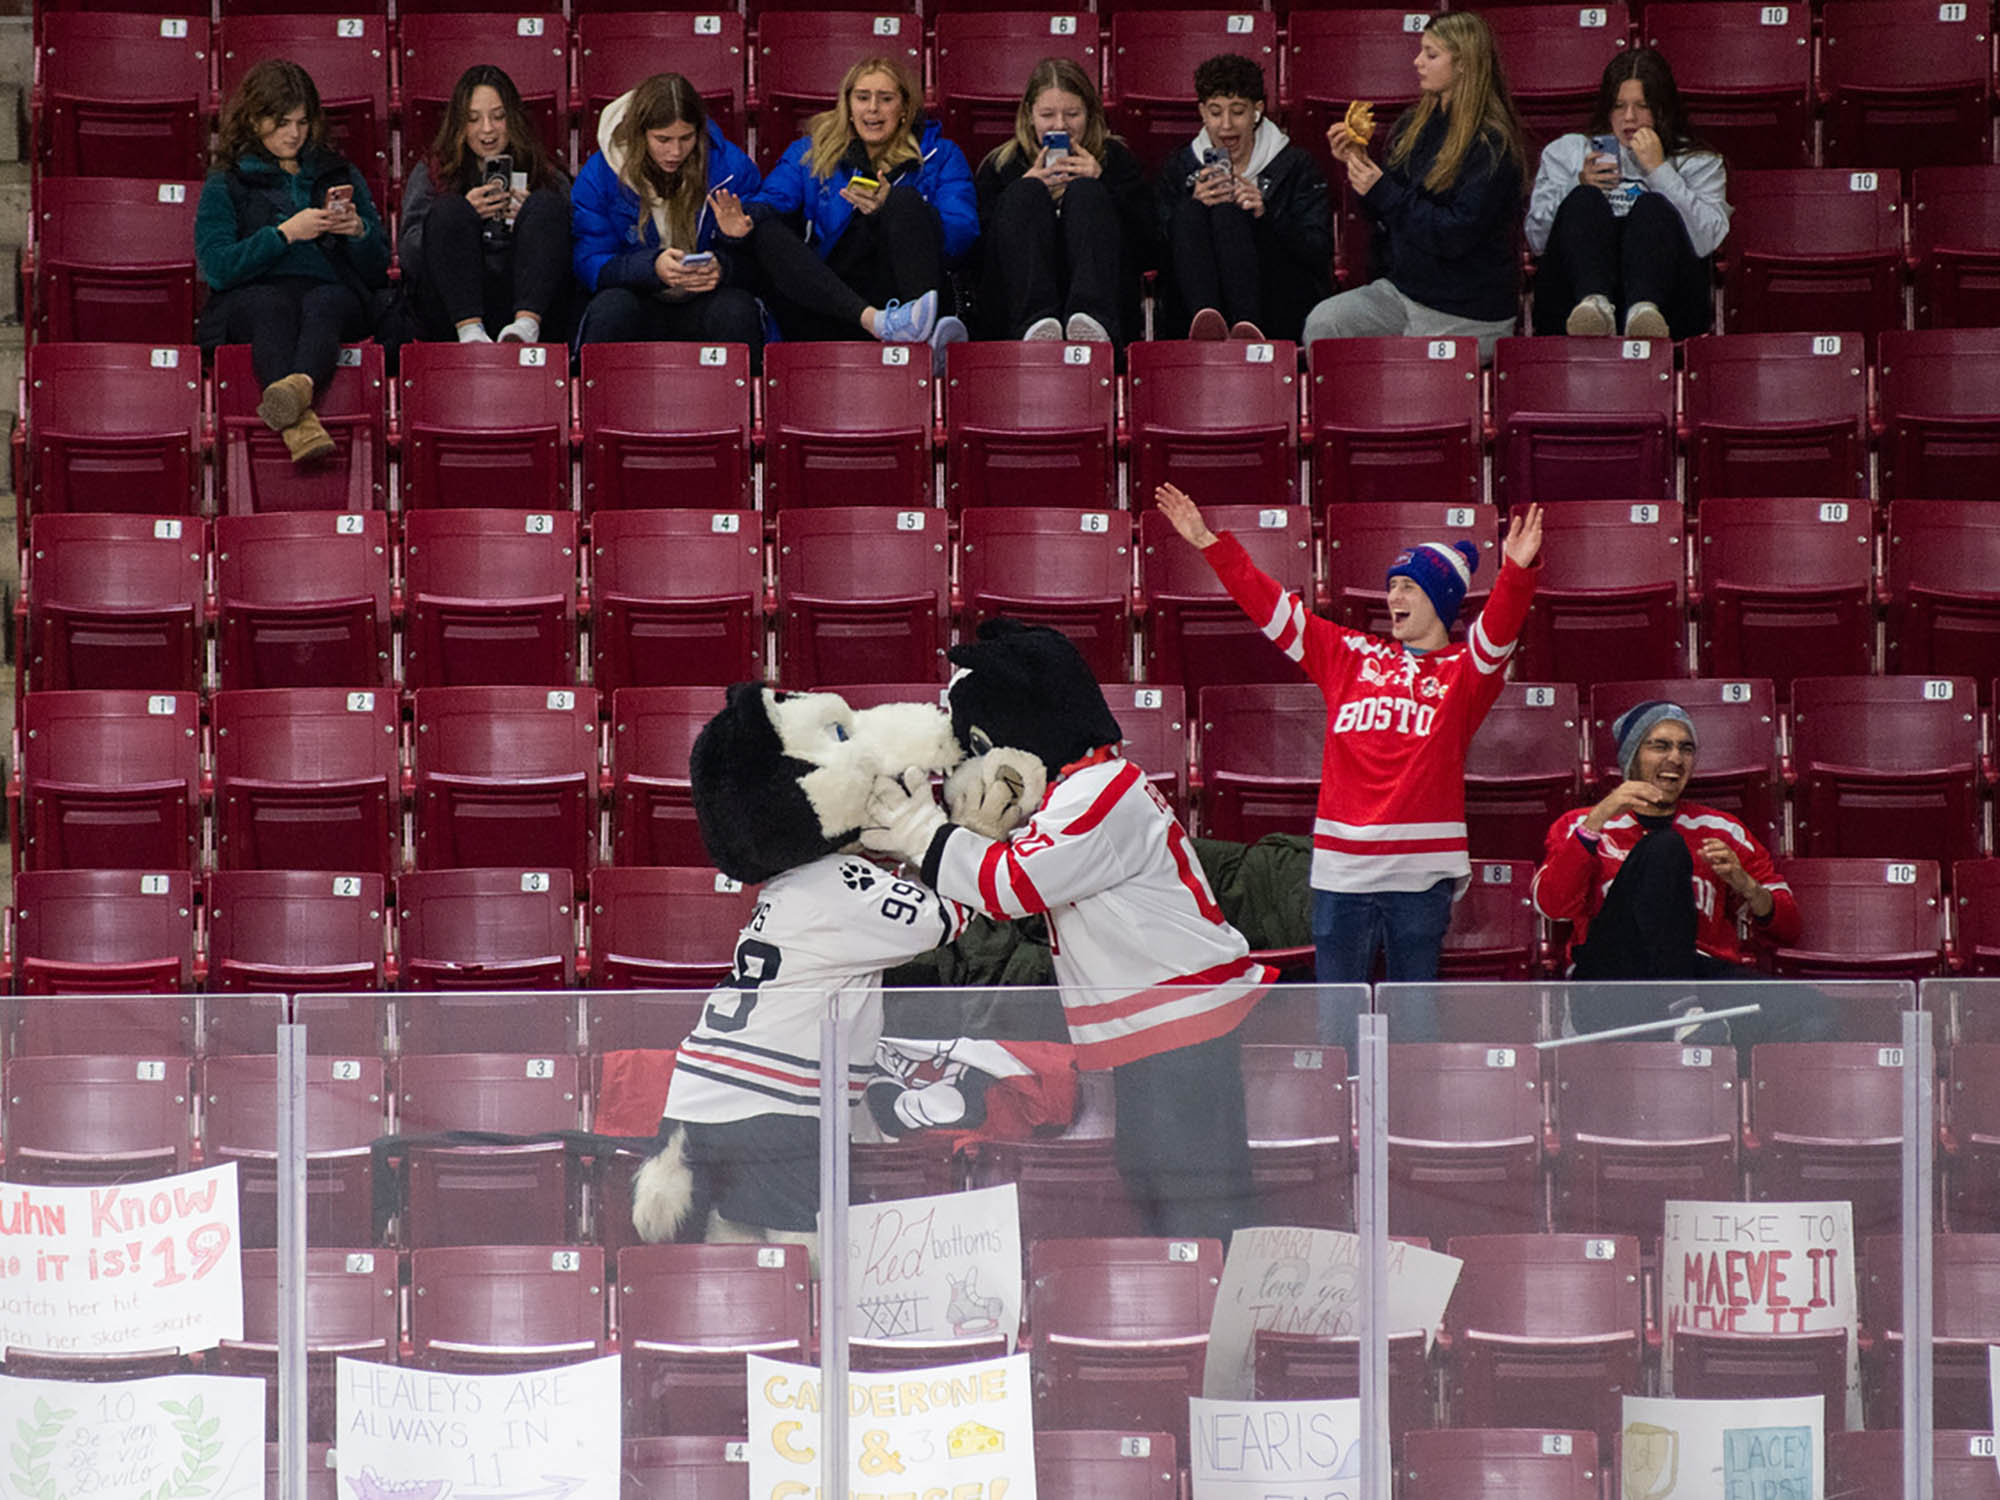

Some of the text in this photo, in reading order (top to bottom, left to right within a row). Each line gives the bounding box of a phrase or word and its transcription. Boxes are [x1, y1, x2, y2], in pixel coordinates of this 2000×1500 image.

[1589, 10, 1597, 25] 9
[1769, 8, 1783, 23] 10
[1947, 6, 1960, 19] 11
[347, 21, 355, 34] 2
[527, 17, 536, 35] 3
[703, 19, 712, 31] 4
[883, 18, 891, 34] 5
[1059, 17, 1067, 32] 6
[1237, 16, 1245, 32] 7
[1412, 16, 1420, 31] 8
[1857, 175, 1871, 189] 10
[1256, 346, 1264, 361] 7
[1437, 340, 1446, 358] 8
[1631, 342, 1641, 360] 9
[1819, 339, 1834, 352] 10
[343, 350, 351, 364] 2
[528, 347, 538, 365] 3
[709, 348, 718, 363] 4
[892, 348, 900, 363] 5
[1071, 347, 1082, 365] 6
[907, 513, 915, 528] 5
[1455, 507, 1465, 525] 8
[1640, 505, 1649, 523] 9
[1826, 503, 1843, 521] 10
[346, 516, 355, 533] 2
[535, 514, 545, 532] 3
[721, 516, 730, 530] 4
[1090, 515, 1100, 532] 6
[1535, 687, 1545, 705] 8
[1732, 684, 1742, 702] 9
[1931, 682, 1947, 699] 10
[356, 693, 365, 710] 2
[556, 692, 566, 709] 3
[1143, 691, 1153, 709] 6
[1334, 696, 1436, 737] BOSTO
[1493, 865, 1502, 882] 8
[1895, 867, 1909, 882] 10
[344, 880, 352, 894] 2
[531, 875, 539, 890] 3
[881, 882, 925, 925] 99
[1303, 1051, 1313, 1069] 7
[1496, 1049, 1506, 1067] 8
[1693, 1049, 1702, 1064] 9
[1886, 1051, 1900, 1065] 10
[343, 1064, 351, 1079] 2
[536, 1062, 544, 1076] 3
[1672, 1214, 1835, 1242] I LIKE TO
[152, 1222, 231, 1288] 19
[861, 1207, 936, 1286] Red
[932, 1223, 1003, 1260] bottoms
[1180, 1246, 1188, 1260] 6
[1596, 1242, 1604, 1256] 8
[356, 1258, 364, 1272] 2
[561, 1250, 571, 1270] 3
[767, 1250, 776, 1266] 4
[1259, 1262, 1304, 1299] love
[1684, 1250, 1792, 1306] MAEVE
[67, 1300, 99, 1317] her
[350, 1366, 571, 1414] HEALEYS ARE
[764, 1369, 1007, 1418] CADERONE
[96, 1391, 136, 1424] 10
[351, 1409, 549, 1449] ALWAYS IN
[734, 1444, 743, 1460] 4
[1130, 1438, 1140, 1456] 6
[1552, 1434, 1562, 1453] 8
[1977, 1439, 1993, 1454] 10
[1728, 1434, 1808, 1473] LACEY
[463, 1451, 507, 1488] 11
